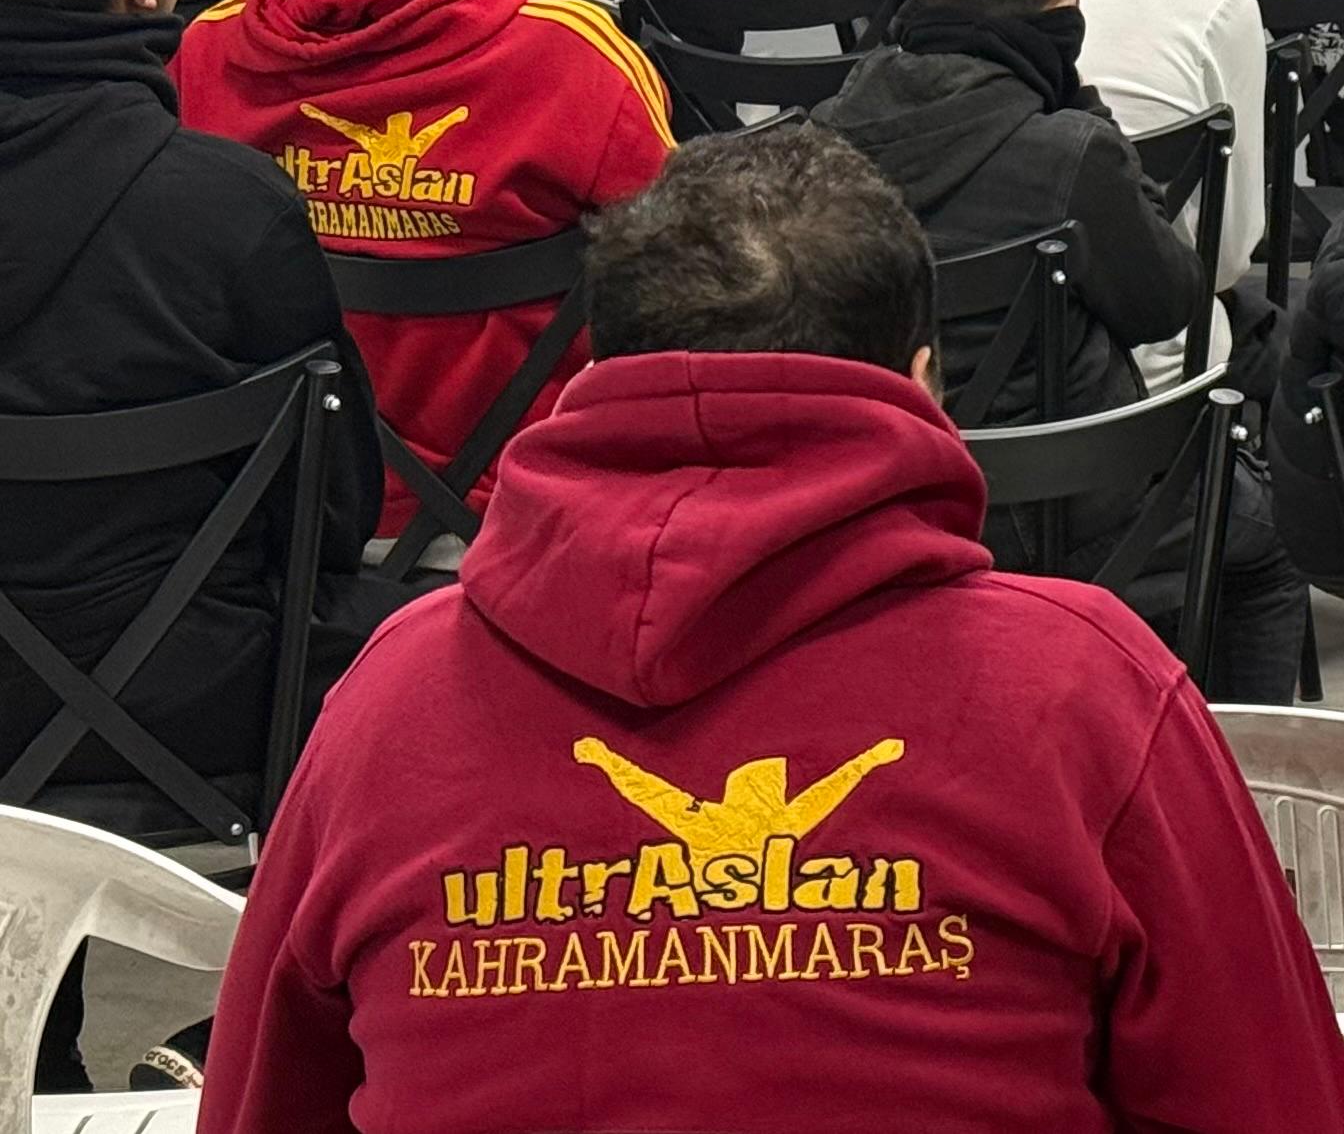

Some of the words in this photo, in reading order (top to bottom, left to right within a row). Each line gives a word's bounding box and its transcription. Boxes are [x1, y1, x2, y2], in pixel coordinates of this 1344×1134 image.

[276, 145, 475, 205] ltrAslan
[443, 836, 922, 926] ultrAslan
[407, 913, 976, 997] KAHRAMANMARAŞ
